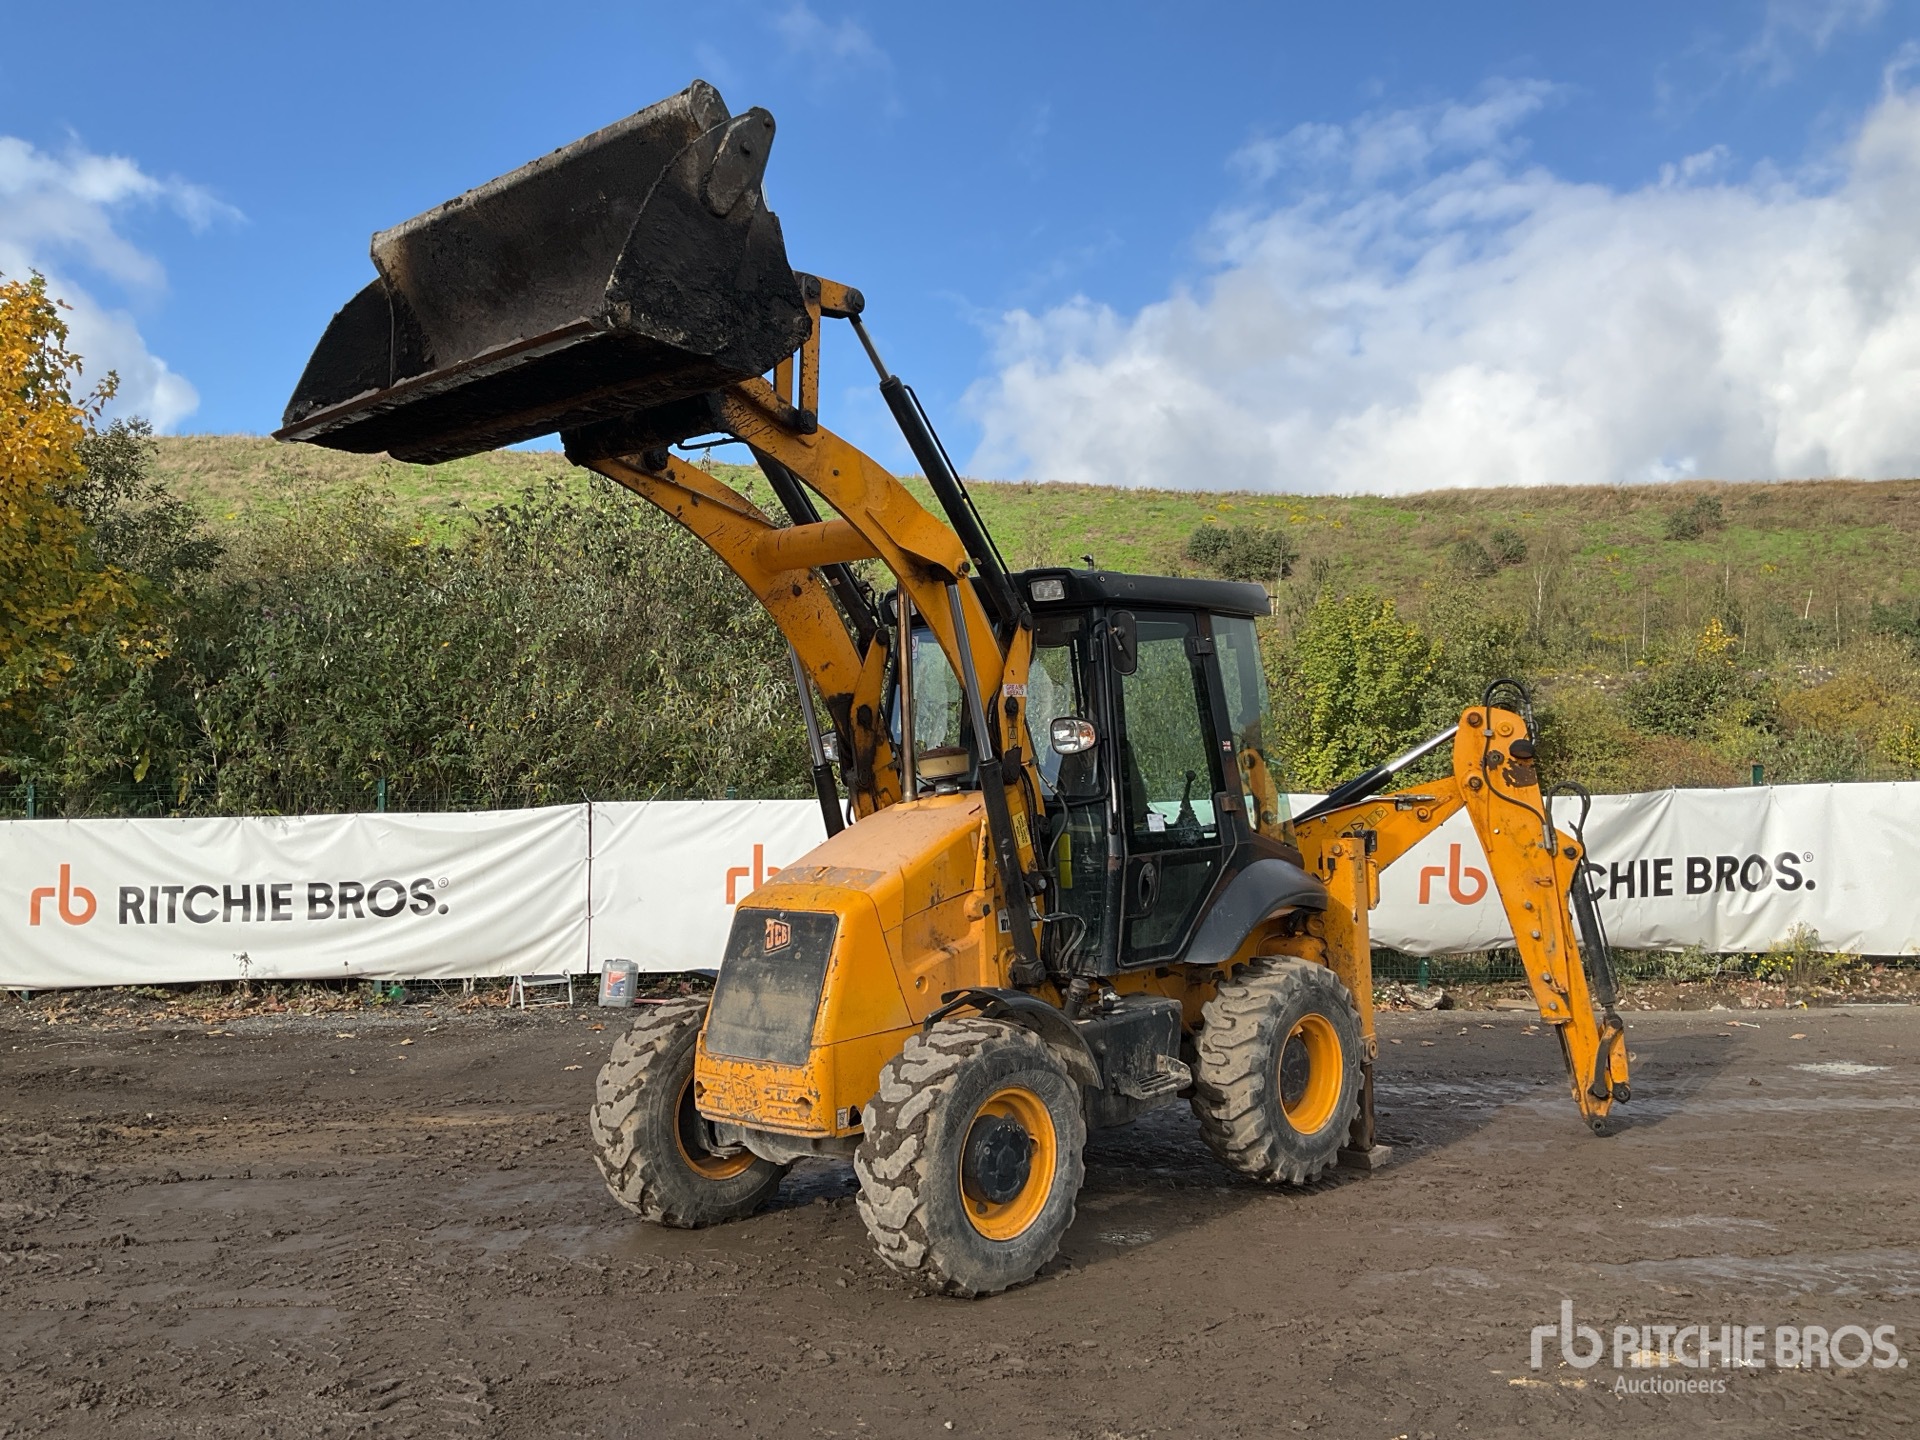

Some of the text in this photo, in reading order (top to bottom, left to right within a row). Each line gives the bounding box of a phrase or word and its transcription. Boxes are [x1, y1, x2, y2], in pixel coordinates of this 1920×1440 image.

[29, 864, 97, 926] rb
[1418, 843, 1488, 905] rb
[1584, 858, 1674, 901] CHIE
[118, 883, 293, 925] RITCHIE
[765, 919, 788, 950] JCB
